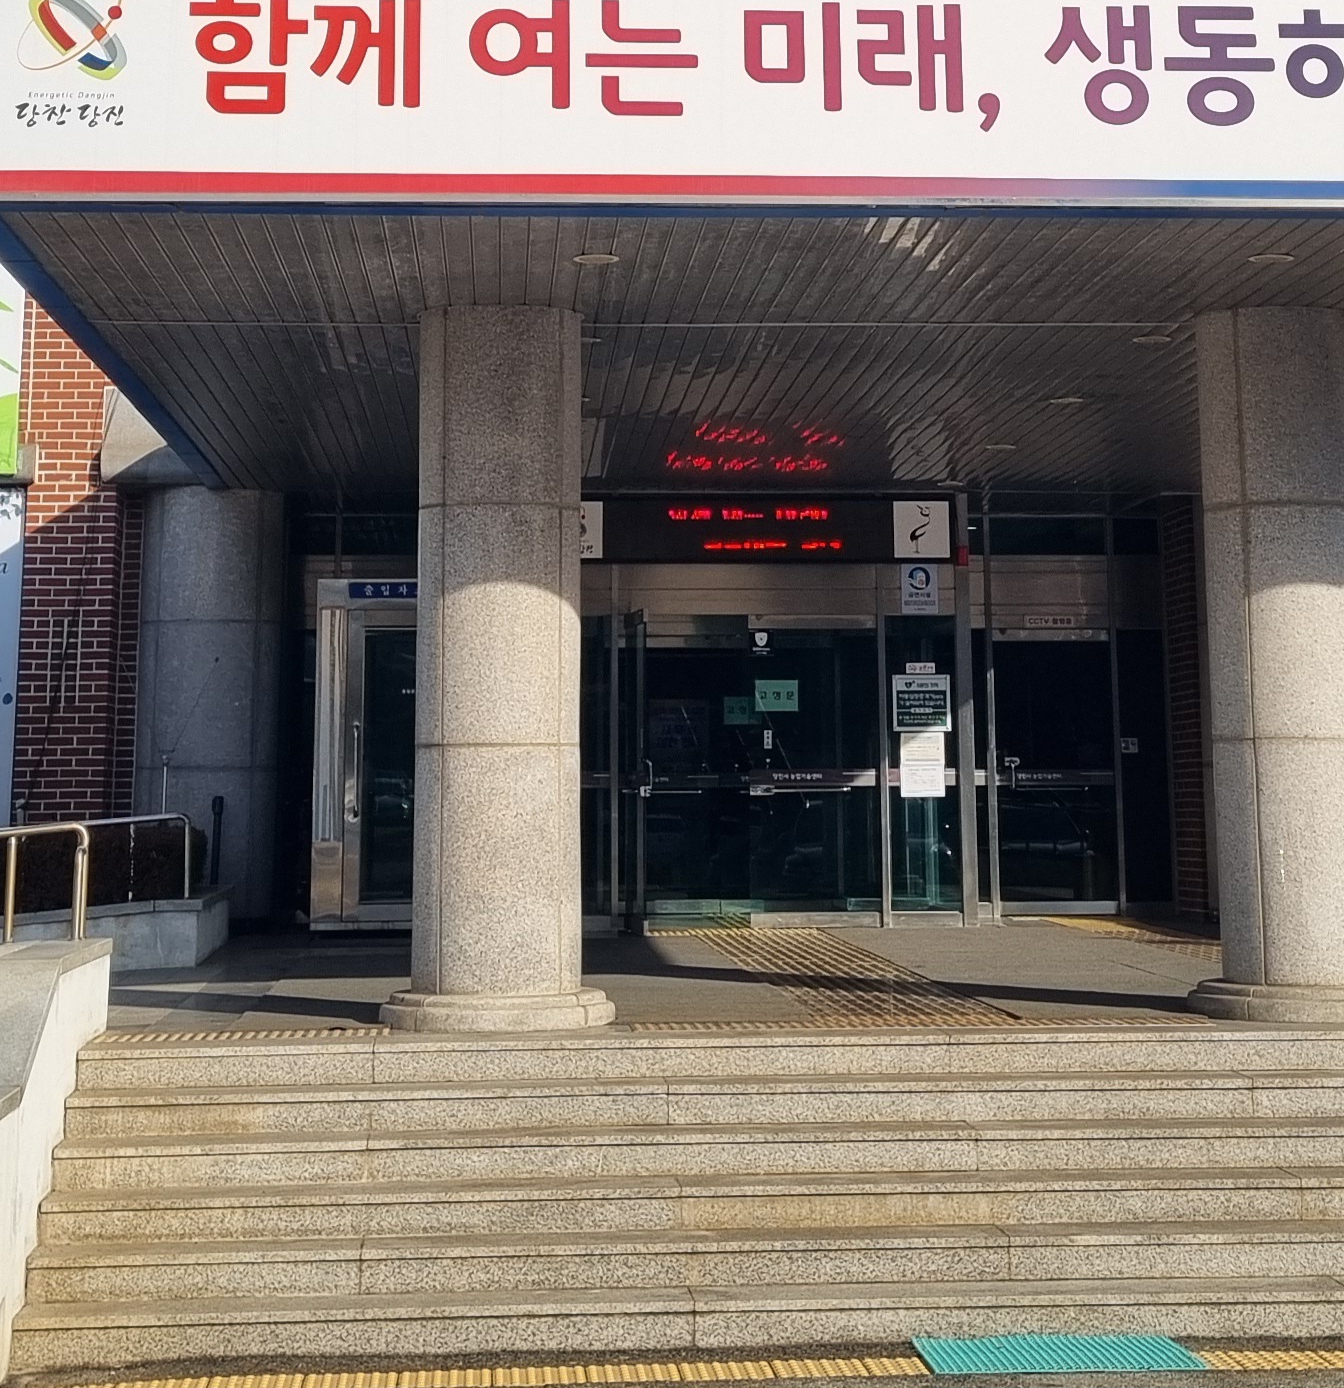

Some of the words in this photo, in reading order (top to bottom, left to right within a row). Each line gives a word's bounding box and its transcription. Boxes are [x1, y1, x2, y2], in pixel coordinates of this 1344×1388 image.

[743, 1, 1001, 133] 미래,
[28, 91, 74, 100] Energetic
[77, 91, 115, 100] Dangjin
[15, 102, 72, 128] 당찬
[77, 103, 124, 128] 당진
[1028, 617, 1050, 626] CCTV
